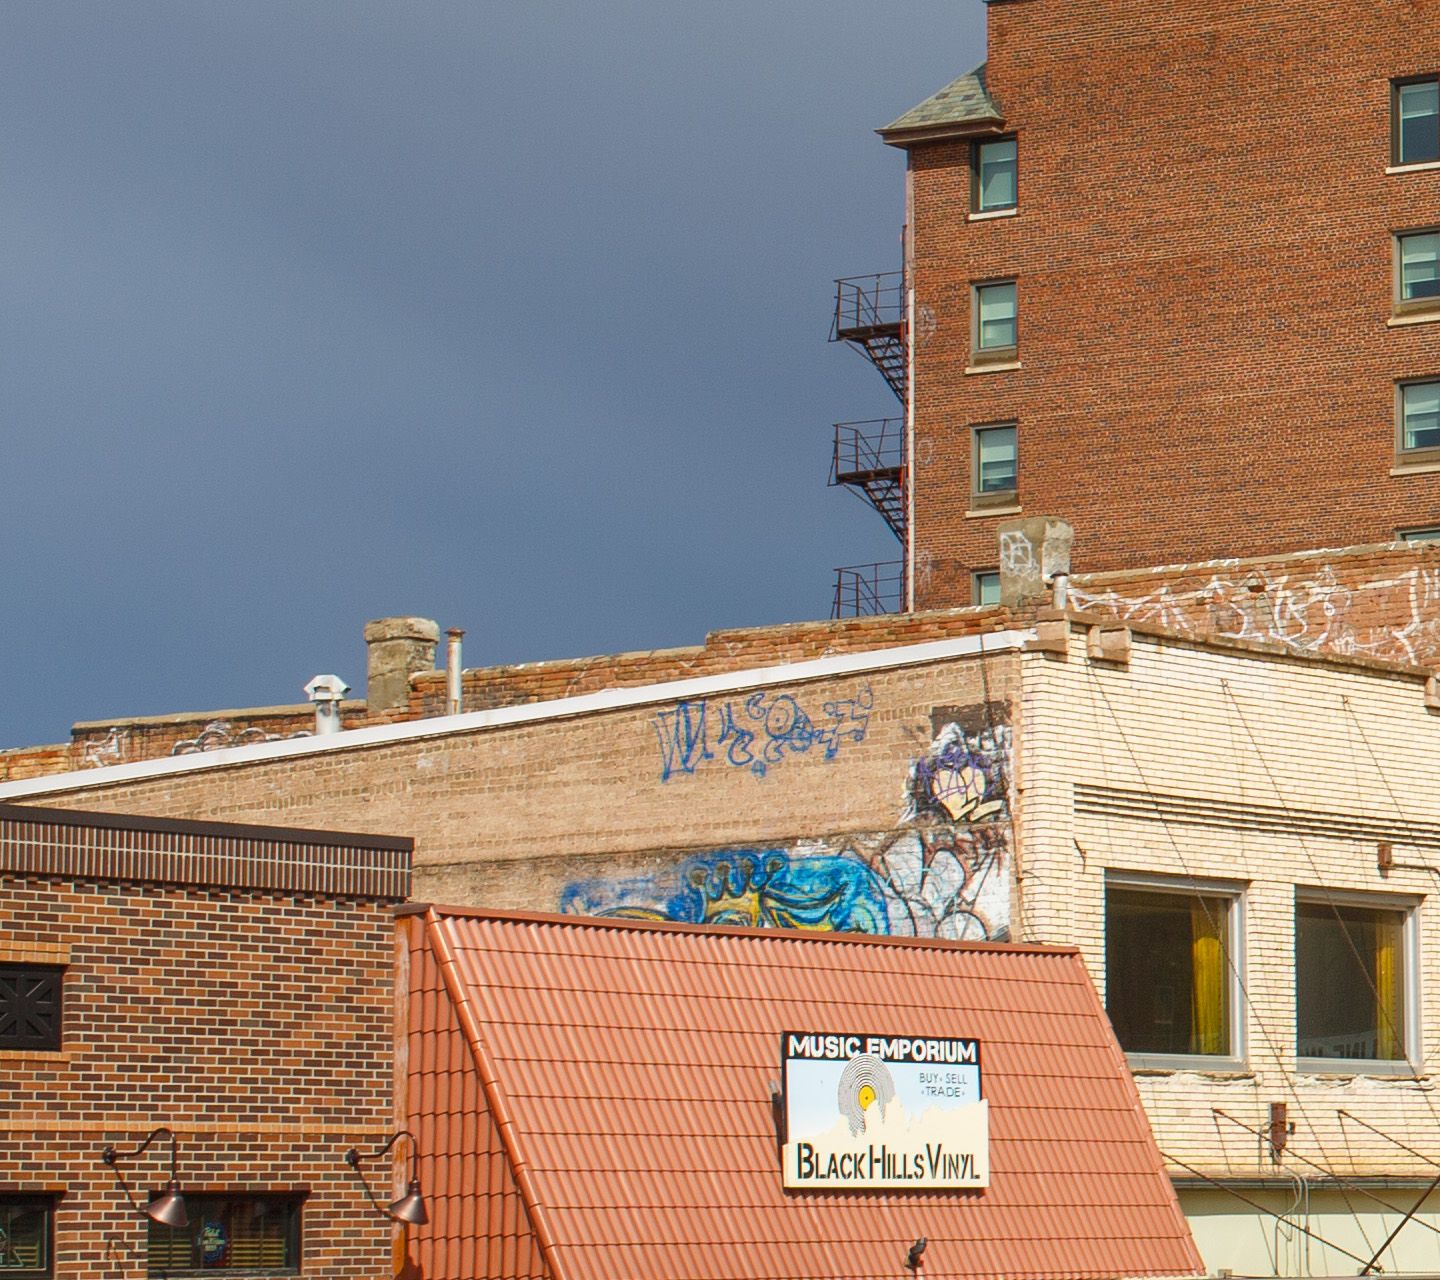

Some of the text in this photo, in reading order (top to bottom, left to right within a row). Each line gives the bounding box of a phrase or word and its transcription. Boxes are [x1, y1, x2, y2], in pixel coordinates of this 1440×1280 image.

[789, 1035, 976, 1063] MUSIC EMPORIUM
[919, 1072, 967, 1085] BUY SELL
[926, 1086, 960, 1097] TRADE
